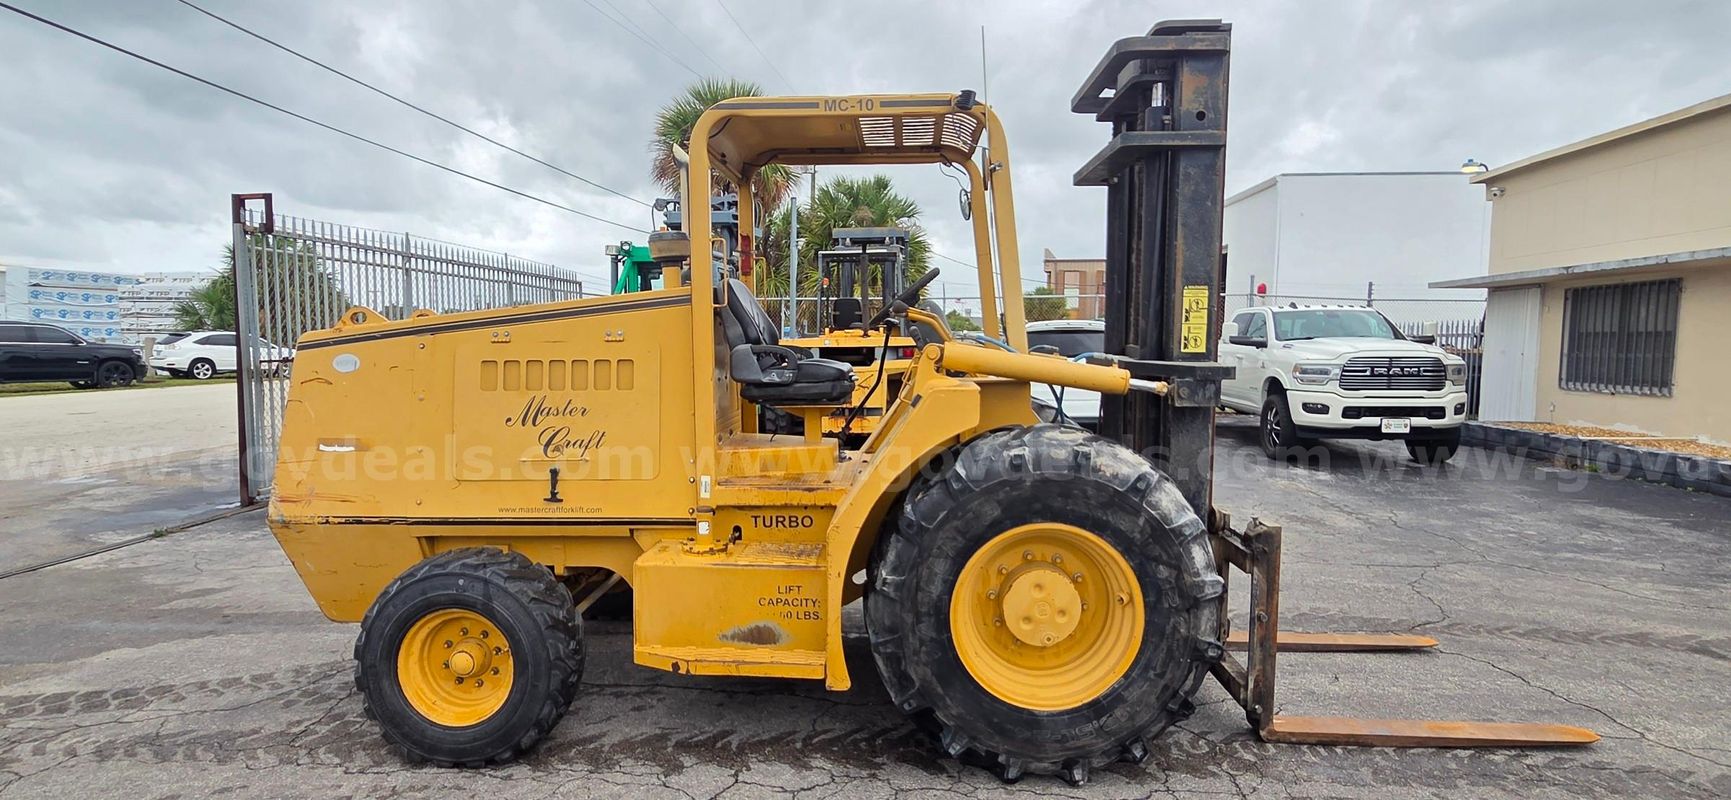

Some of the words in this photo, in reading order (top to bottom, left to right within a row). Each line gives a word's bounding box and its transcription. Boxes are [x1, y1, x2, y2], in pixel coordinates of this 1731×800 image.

[824, 98, 874, 112] MC-10
[1373, 367, 1419, 376] RAM
[505, 395, 591, 427] Master
[538, 426, 606, 459] Craft
[751, 515, 814, 528] TURBO
[777, 585, 803, 595] LIFT
[758, 597, 821, 608] CAPACITY:
[796, 610, 823, 621] LBS.
